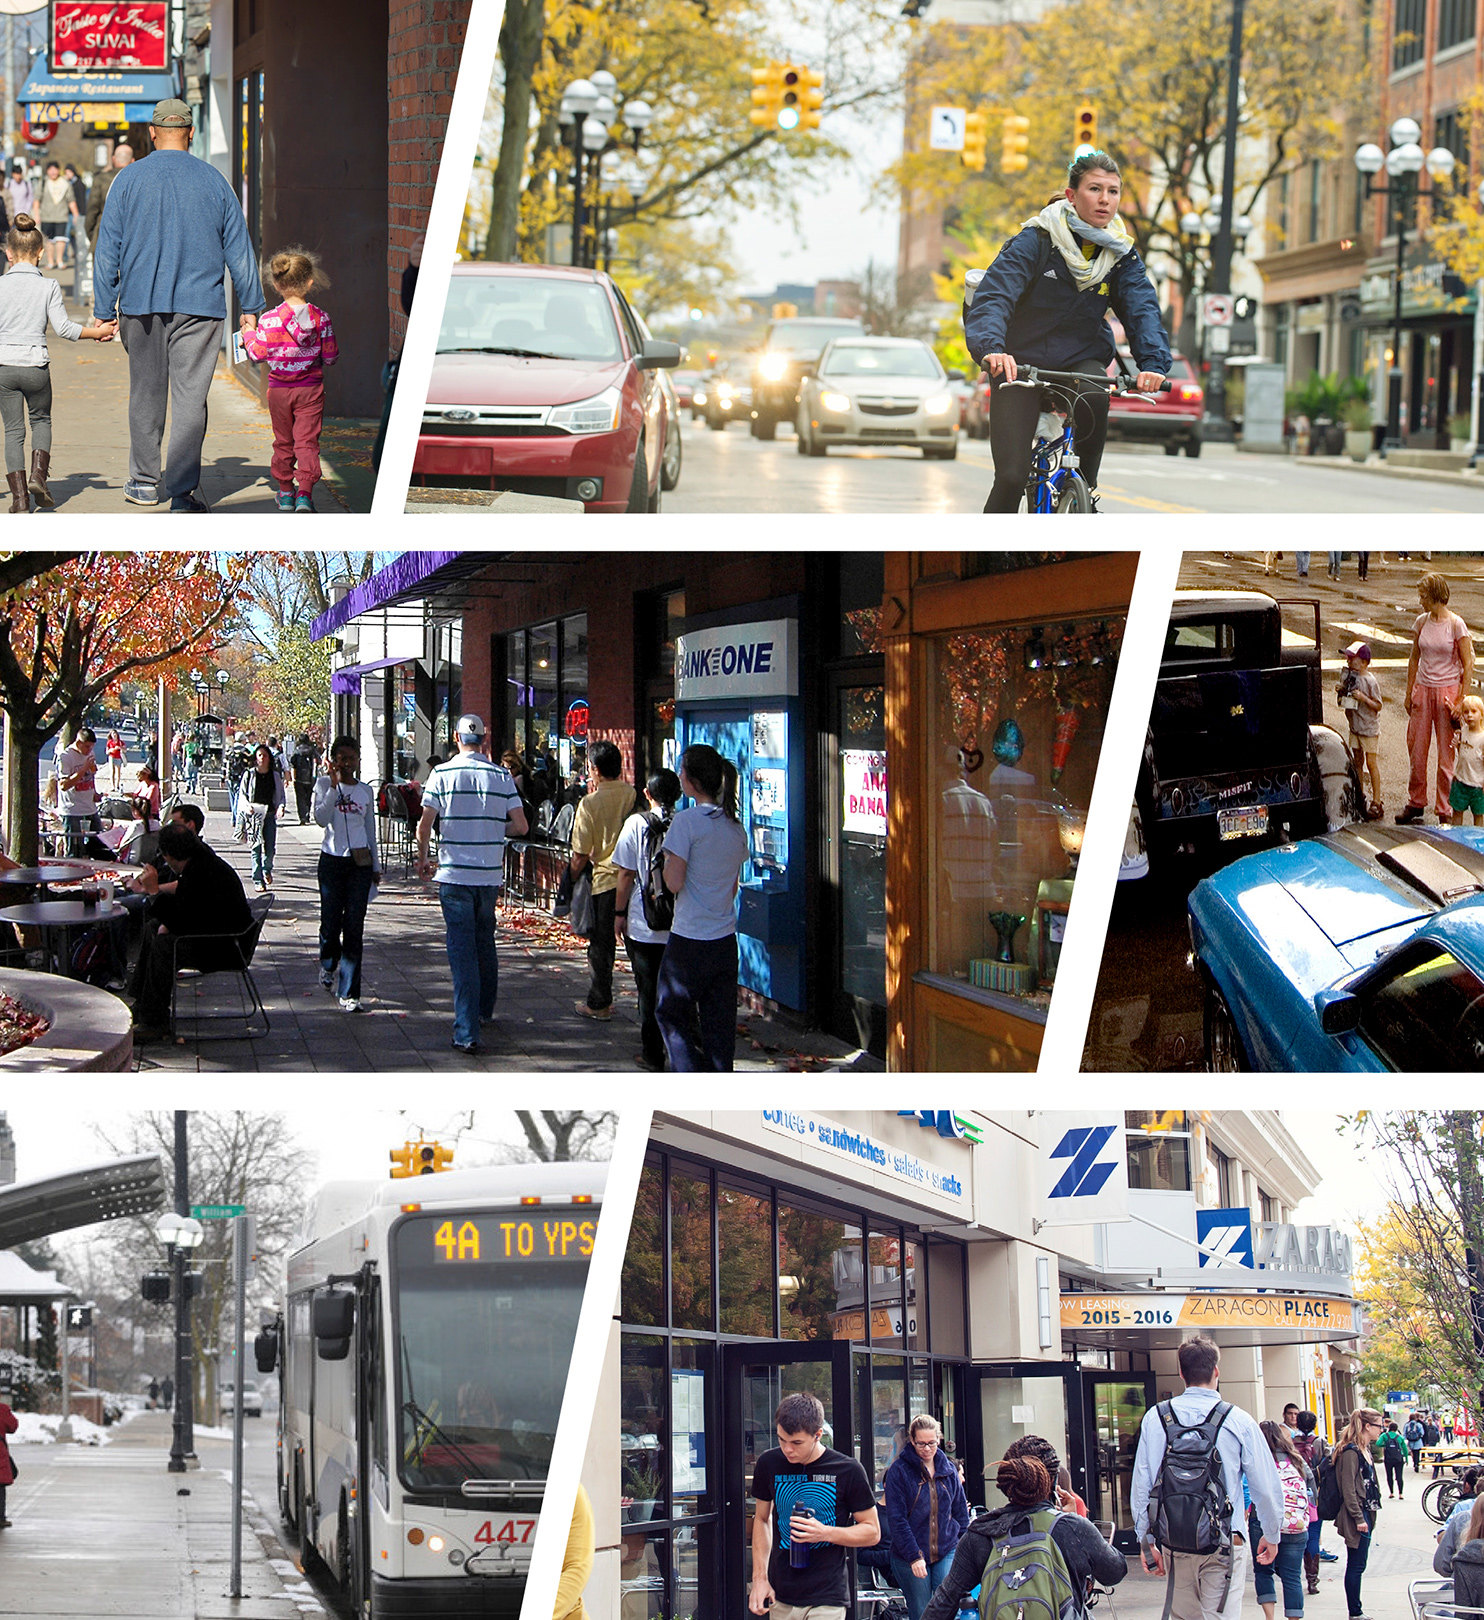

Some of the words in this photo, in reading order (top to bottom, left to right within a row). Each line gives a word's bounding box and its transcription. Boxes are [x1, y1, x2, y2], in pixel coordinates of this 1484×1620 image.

[56, 8, 97, 38] Taste
[98, 7, 118, 30] of
[115, 8, 164, 39] India
[85, 33, 135, 49] SUVAI
[27, 82, 80, 96] Japanese
[81, 82, 144, 96] Restaurant
[720, 641, 774, 676] ONE
[1219, 781, 1253, 800] MISFIT
[818, 1123, 886, 1167] sandwiches
[893, 1153, 924, 1184] salads
[932, 1170, 962, 1198] snacks
[201, 1207, 233, 1217] William
[434, 1221, 480, 1260] 4A
[499, 1222, 534, 1257] TO
[543, 1220, 599, 1256] YPS
[1080, 1299, 1130, 1311] LEASING
[1189, 1298, 1281, 1316] ZARAGON
[1284, 1300, 1330, 1318] PLACE
[1273, 1314, 1296, 1327] CALL
[812, 1474, 825, 1483] TURN
[474, 1520, 536, 1545] 447
